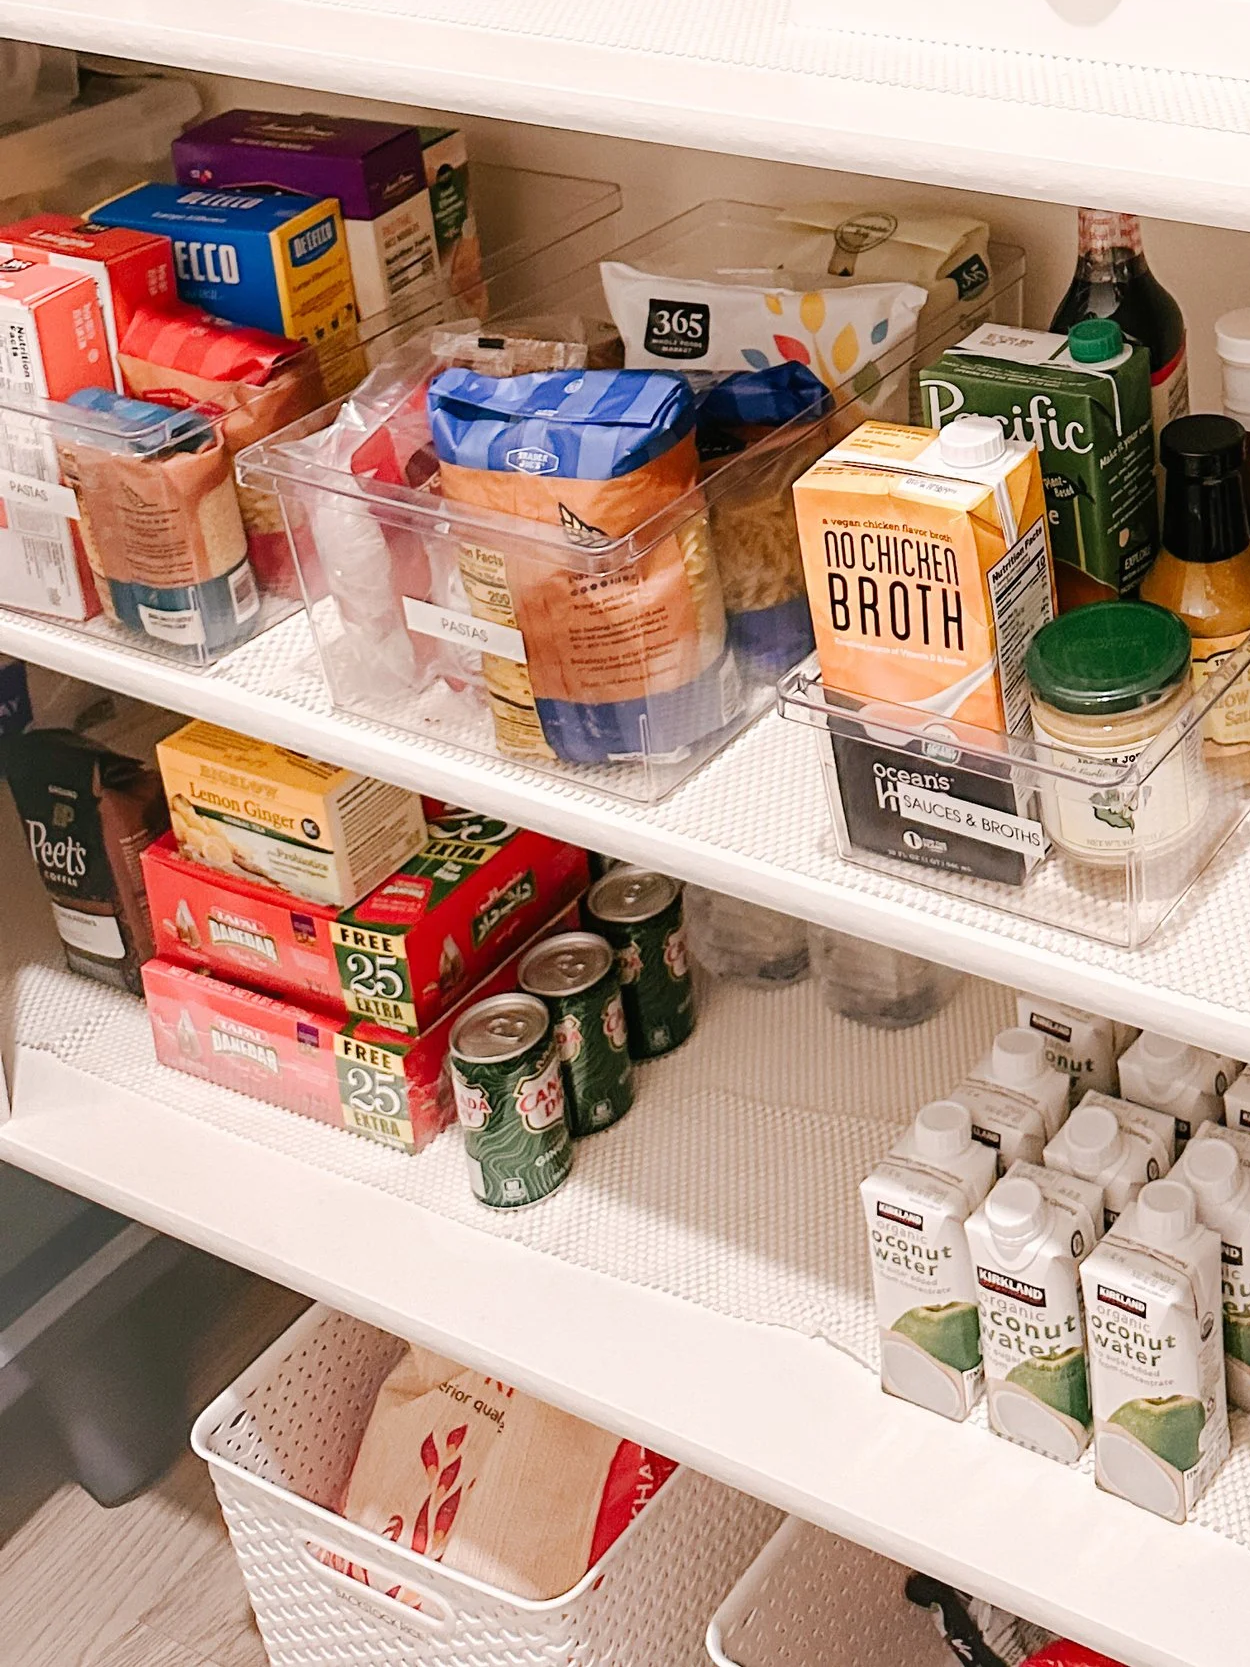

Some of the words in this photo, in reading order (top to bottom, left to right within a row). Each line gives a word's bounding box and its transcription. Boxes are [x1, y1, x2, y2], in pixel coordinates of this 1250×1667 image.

[652, 309, 703, 337] 365
[10, 326, 18, 357] Facts
[17, 326, 30, 378] Nutrition
[651, 338, 677, 347] WHOLE
[679, 340, 702, 348] FOODS
[661, 345, 692, 355] MARKET
[517, 452, 548, 463] TRADER
[822, 517, 828, 525] a
[831, 519, 861, 529] vegan
[863, 520, 900, 532] chicken
[902, 524, 927, 537] flavor
[992, 543, 1026, 583] Nutrition
[1024, 527, 1043, 549] Facts
[1036, 557, 1046, 571] 10
[488, 590, 511, 604] 200
[828, 572, 964, 651] BROTH
[440, 616, 489, 642] PASTAS
[872, 762, 951, 791] ocean's
[189, 781, 241, 813] Lemon
[243, 800, 295, 830] Ginger
[903, 794, 962, 823] SAUCES
[966, 814, 977, 828] &
[982, 818, 1041, 847] BROTHS
[26, 819, 87, 876] Peet's
[340, 927, 393, 952] FREE
[347, 953, 404, 1000] 25
[356, 996, 404, 1021] EXTRA
[343, 1040, 393, 1070] FREE
[348, 1067, 401, 1116] 25
[355, 1109, 400, 1137] EXTRA
[979, 1268, 1045, 1304] KIRKLAND
